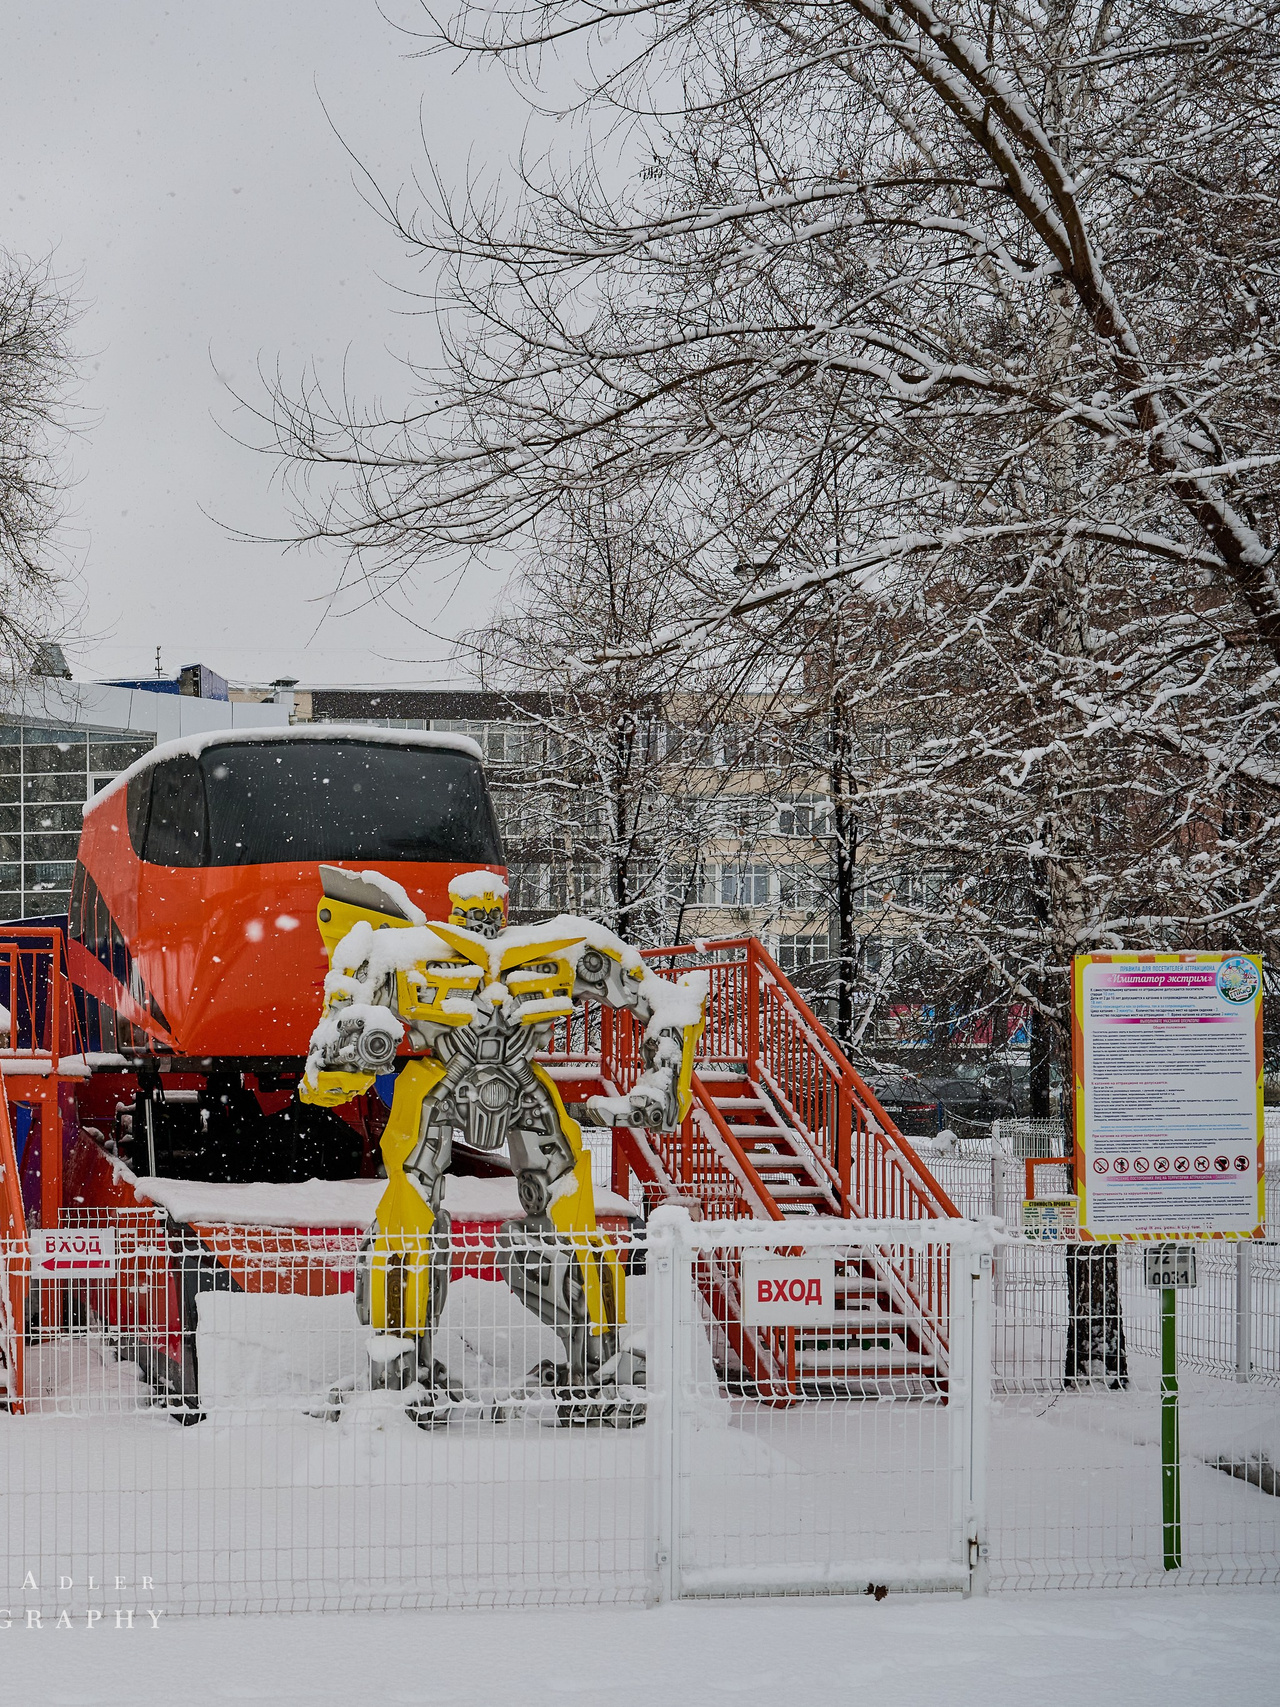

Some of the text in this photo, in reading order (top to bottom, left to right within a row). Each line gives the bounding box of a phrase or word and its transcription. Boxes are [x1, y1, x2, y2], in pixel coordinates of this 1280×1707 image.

[1107, 973, 1213, 986] «Имитатор экстрим»
[46, 1236, 101, 1255] ВХОД
[1153, 1251, 1170, 1264] 72
[758, 1279, 822, 1305] ВХОД
